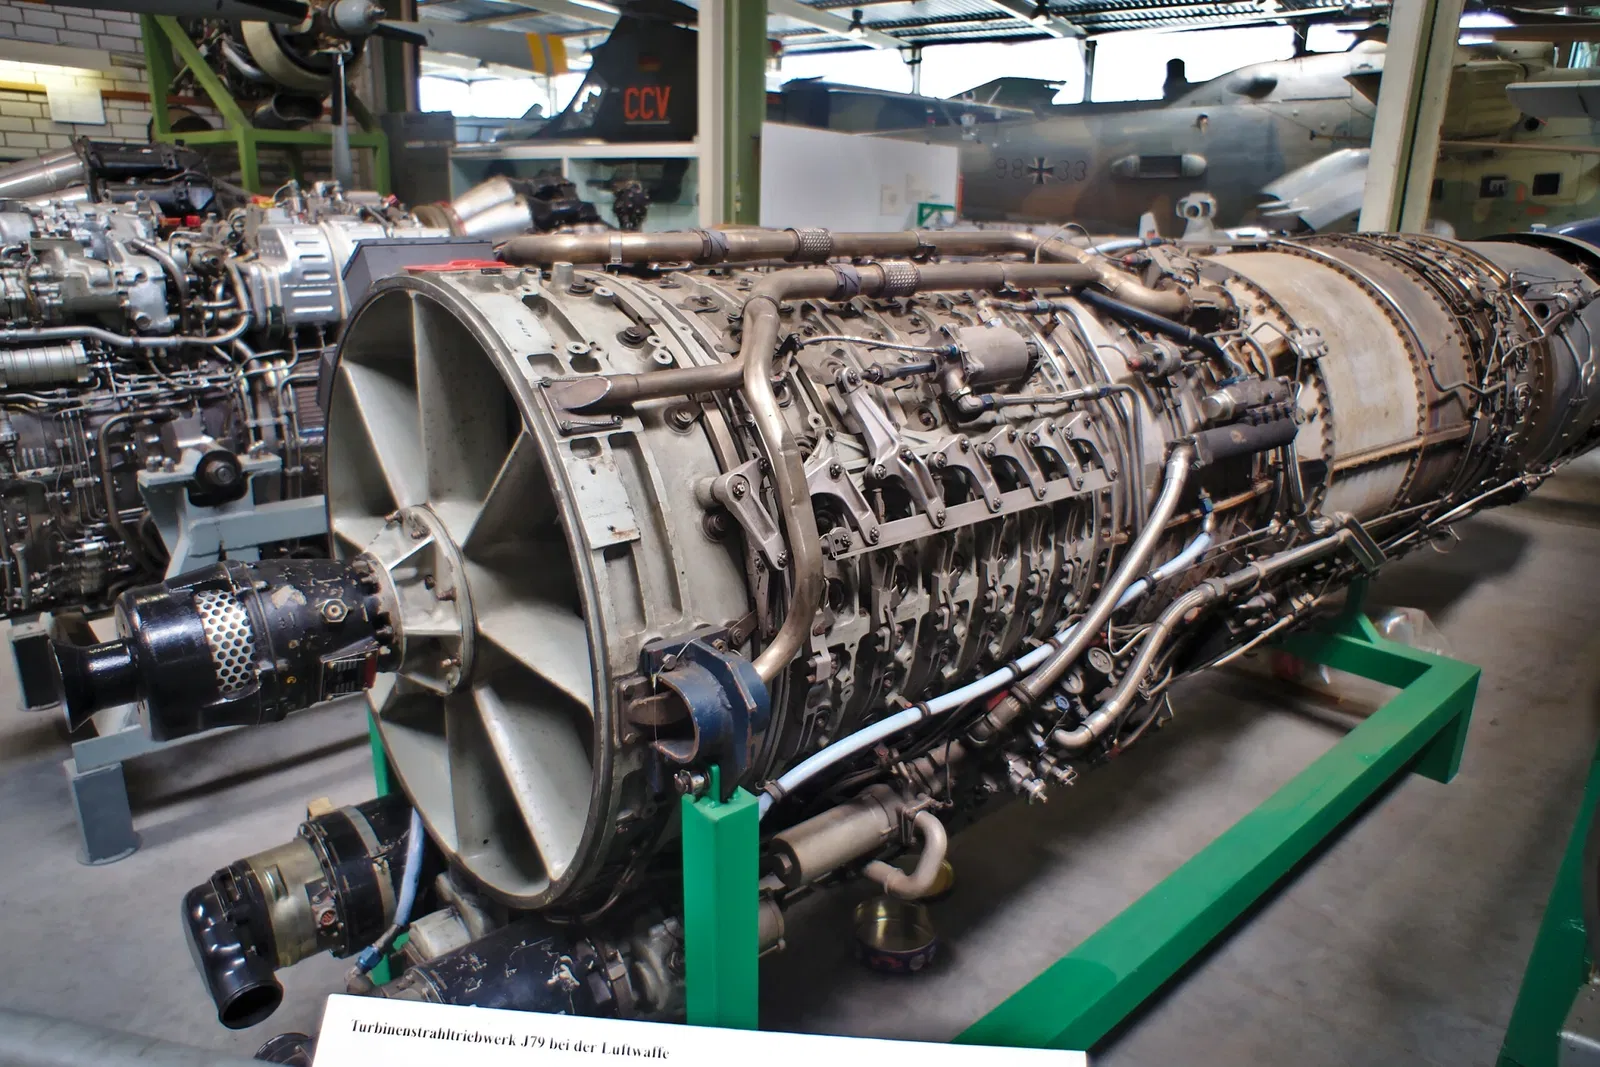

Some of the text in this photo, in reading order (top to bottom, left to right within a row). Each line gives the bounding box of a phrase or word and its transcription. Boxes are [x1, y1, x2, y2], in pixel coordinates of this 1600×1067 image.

[624, 86, 671, 120] CCV
[995, 158, 1087, 182] 98 33
[351, 1018, 670, 1060] Turbinenstrahltriebwerk J79 bei der Luftwaffe
